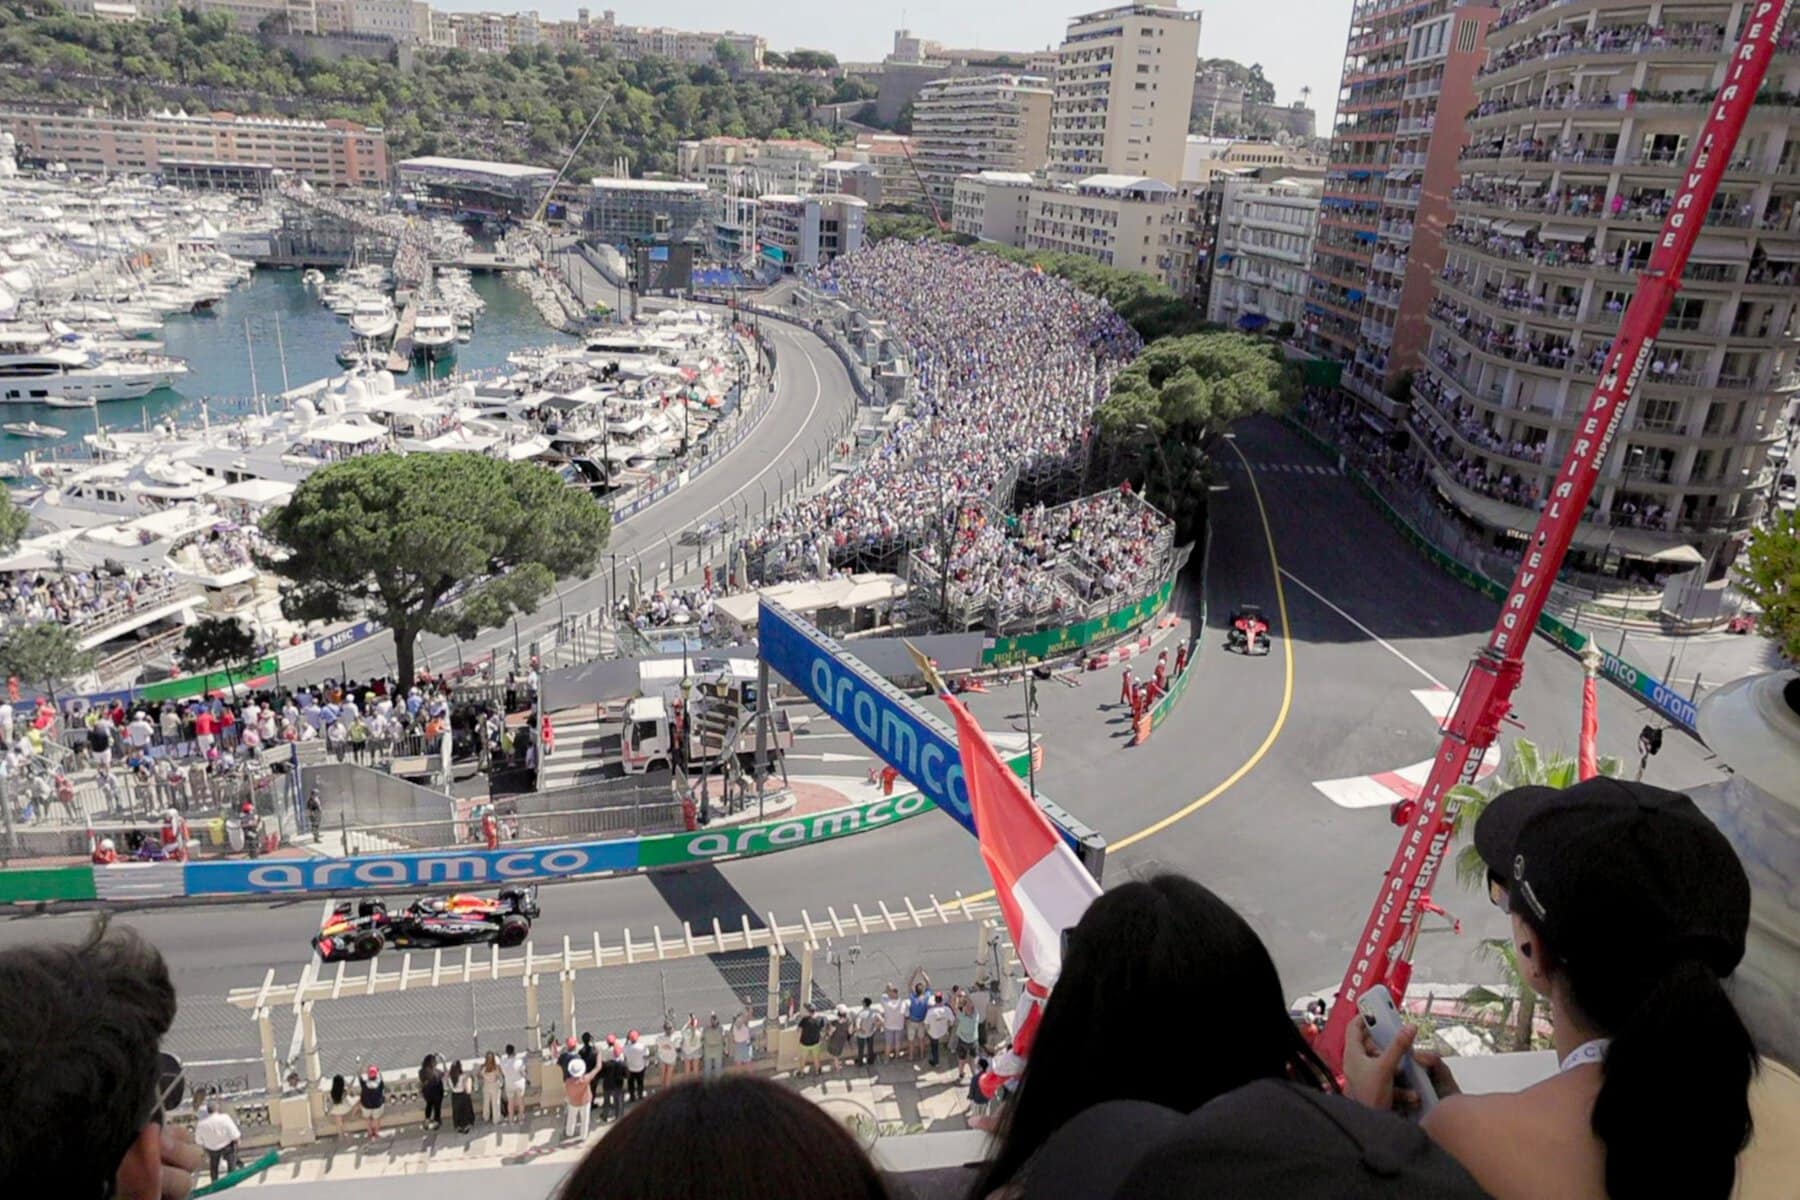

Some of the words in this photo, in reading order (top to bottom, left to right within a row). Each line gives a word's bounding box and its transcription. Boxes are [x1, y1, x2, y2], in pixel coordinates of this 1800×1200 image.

[1549, 352, 1623, 518] IMPERIAL
[1592, 399, 1628, 471] IMPERIAL
[1622, 336, 1655, 396] LEVAGE
[247, 849, 590, 888] aramco
[686, 795, 926, 857] aramco
[1399, 830, 1449, 924] IMPERIAL
